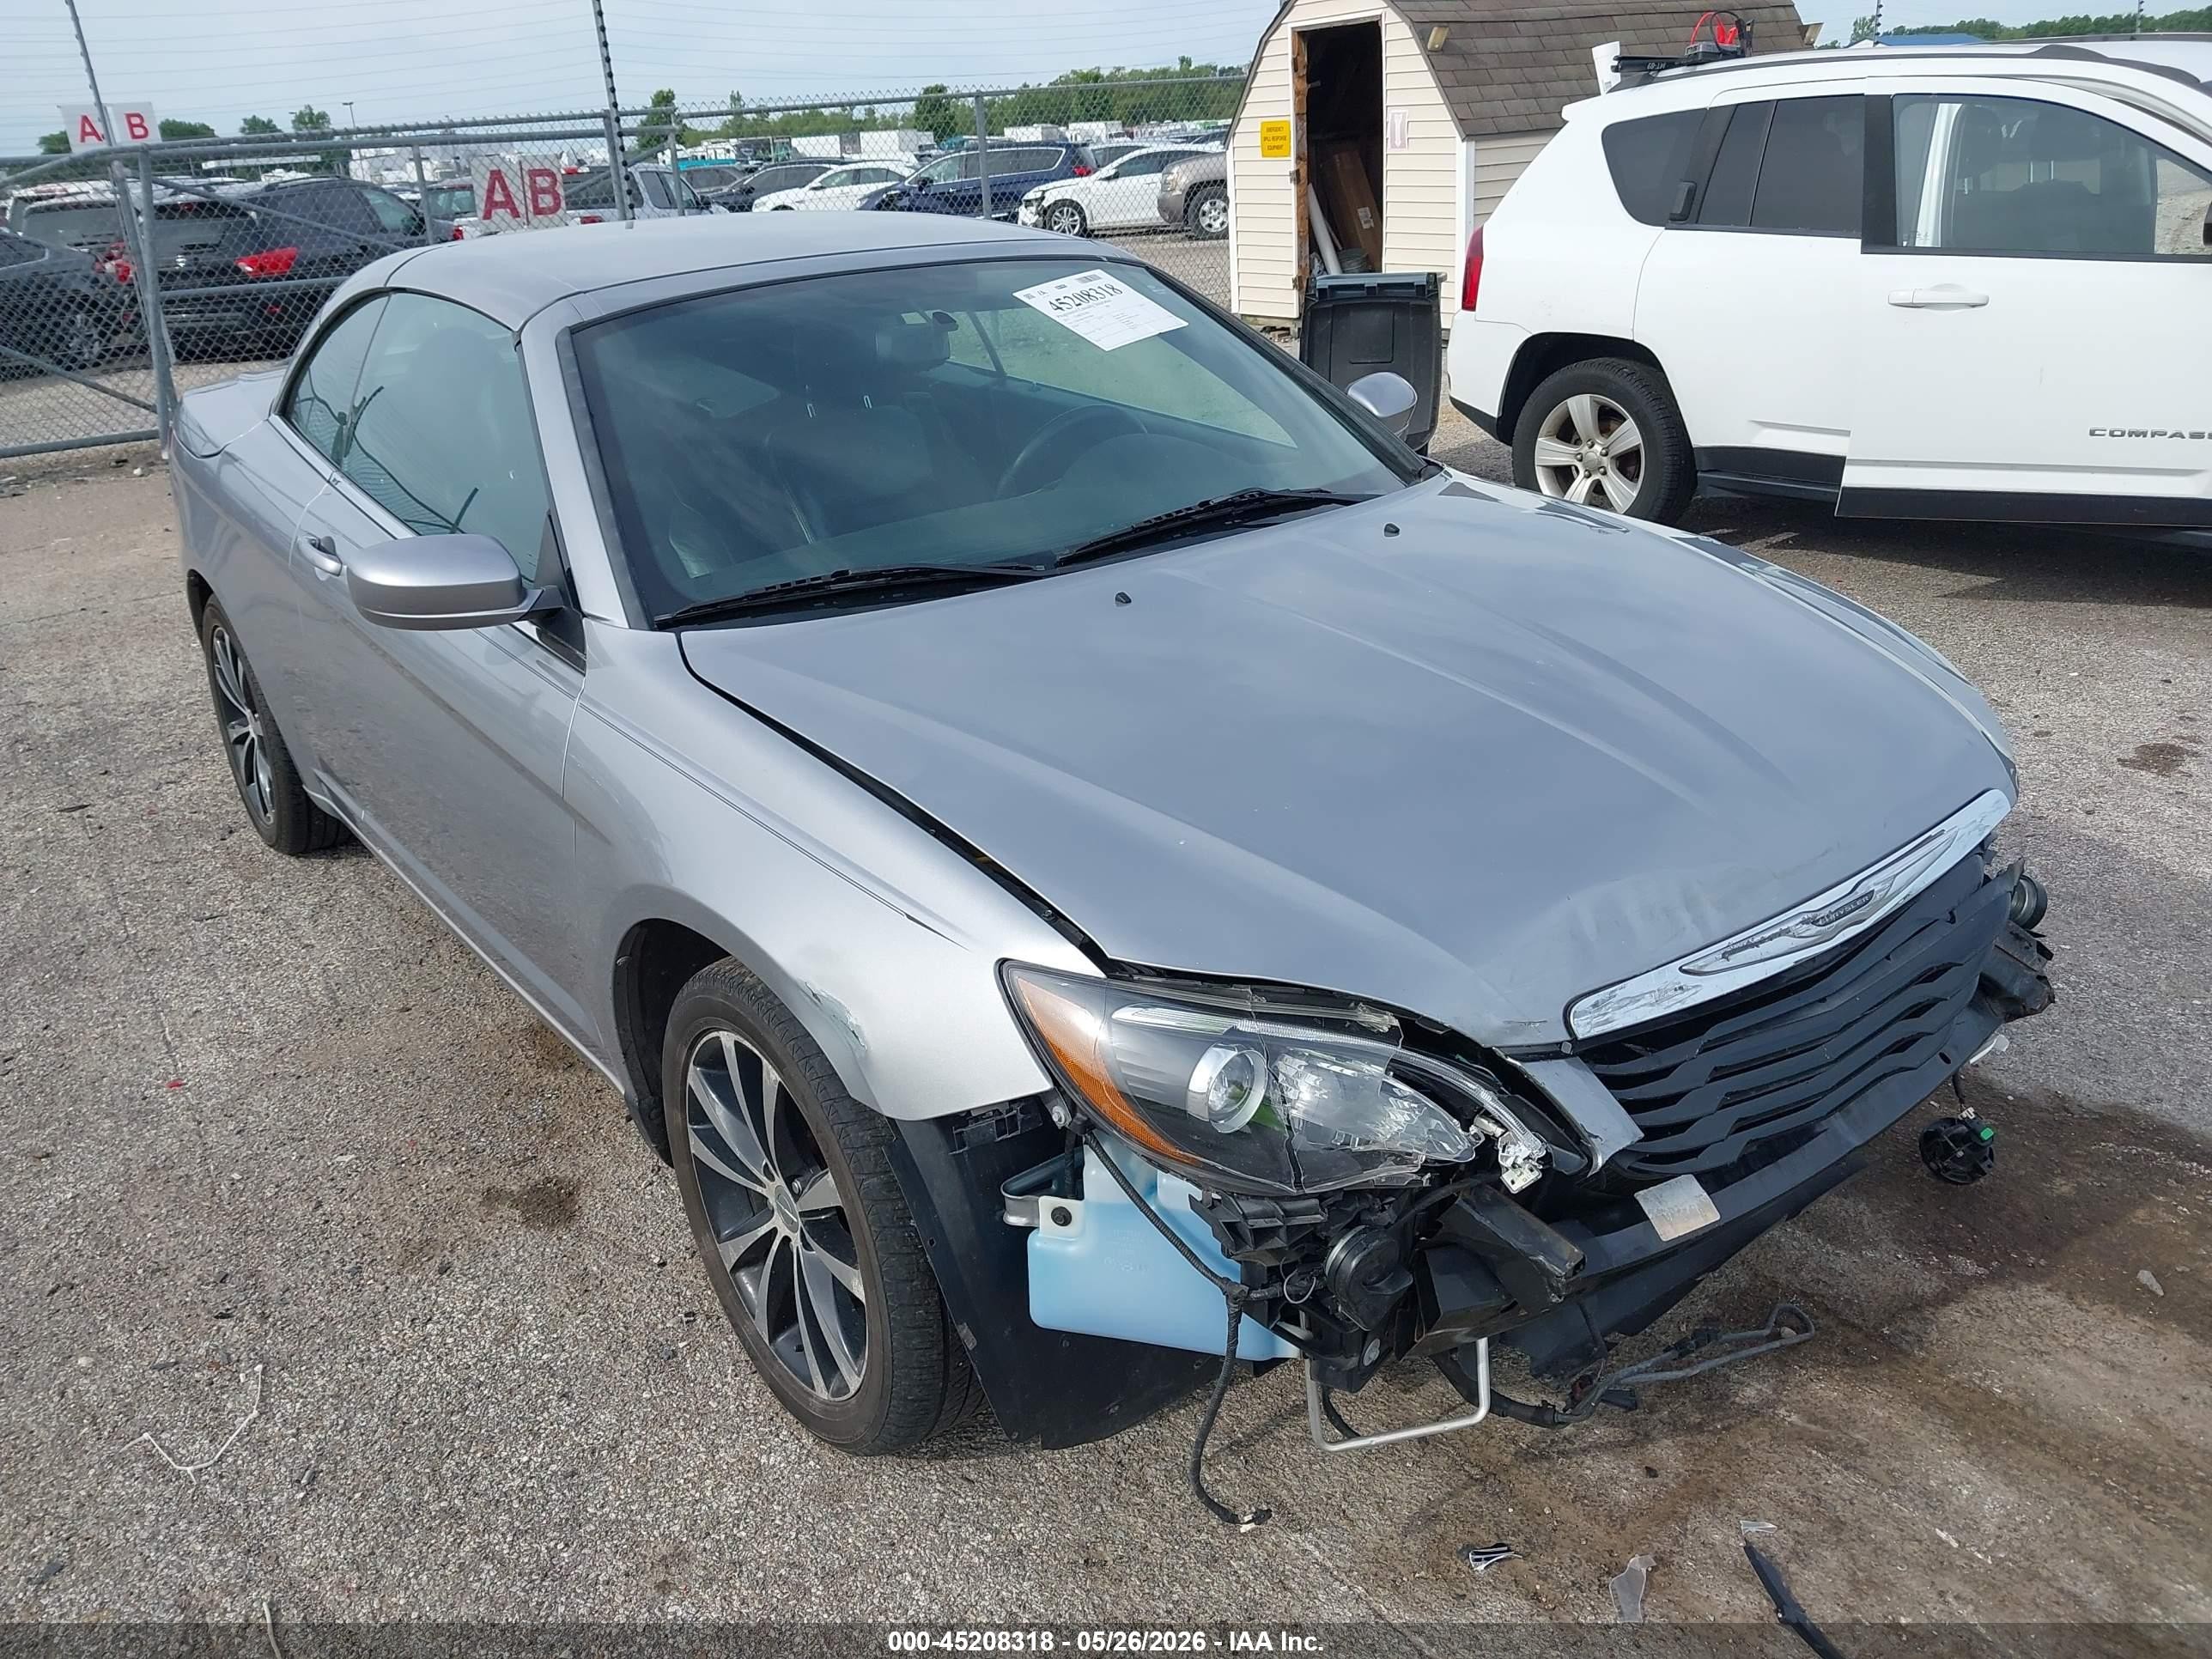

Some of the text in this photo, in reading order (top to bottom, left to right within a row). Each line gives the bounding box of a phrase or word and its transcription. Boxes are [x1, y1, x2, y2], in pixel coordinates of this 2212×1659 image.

[79, 112, 149, 143] A B
[483, 168, 562, 220] A B
[1048, 283, 1123, 311] 45208318
[2089, 428, 2212, 440] COMPAS
